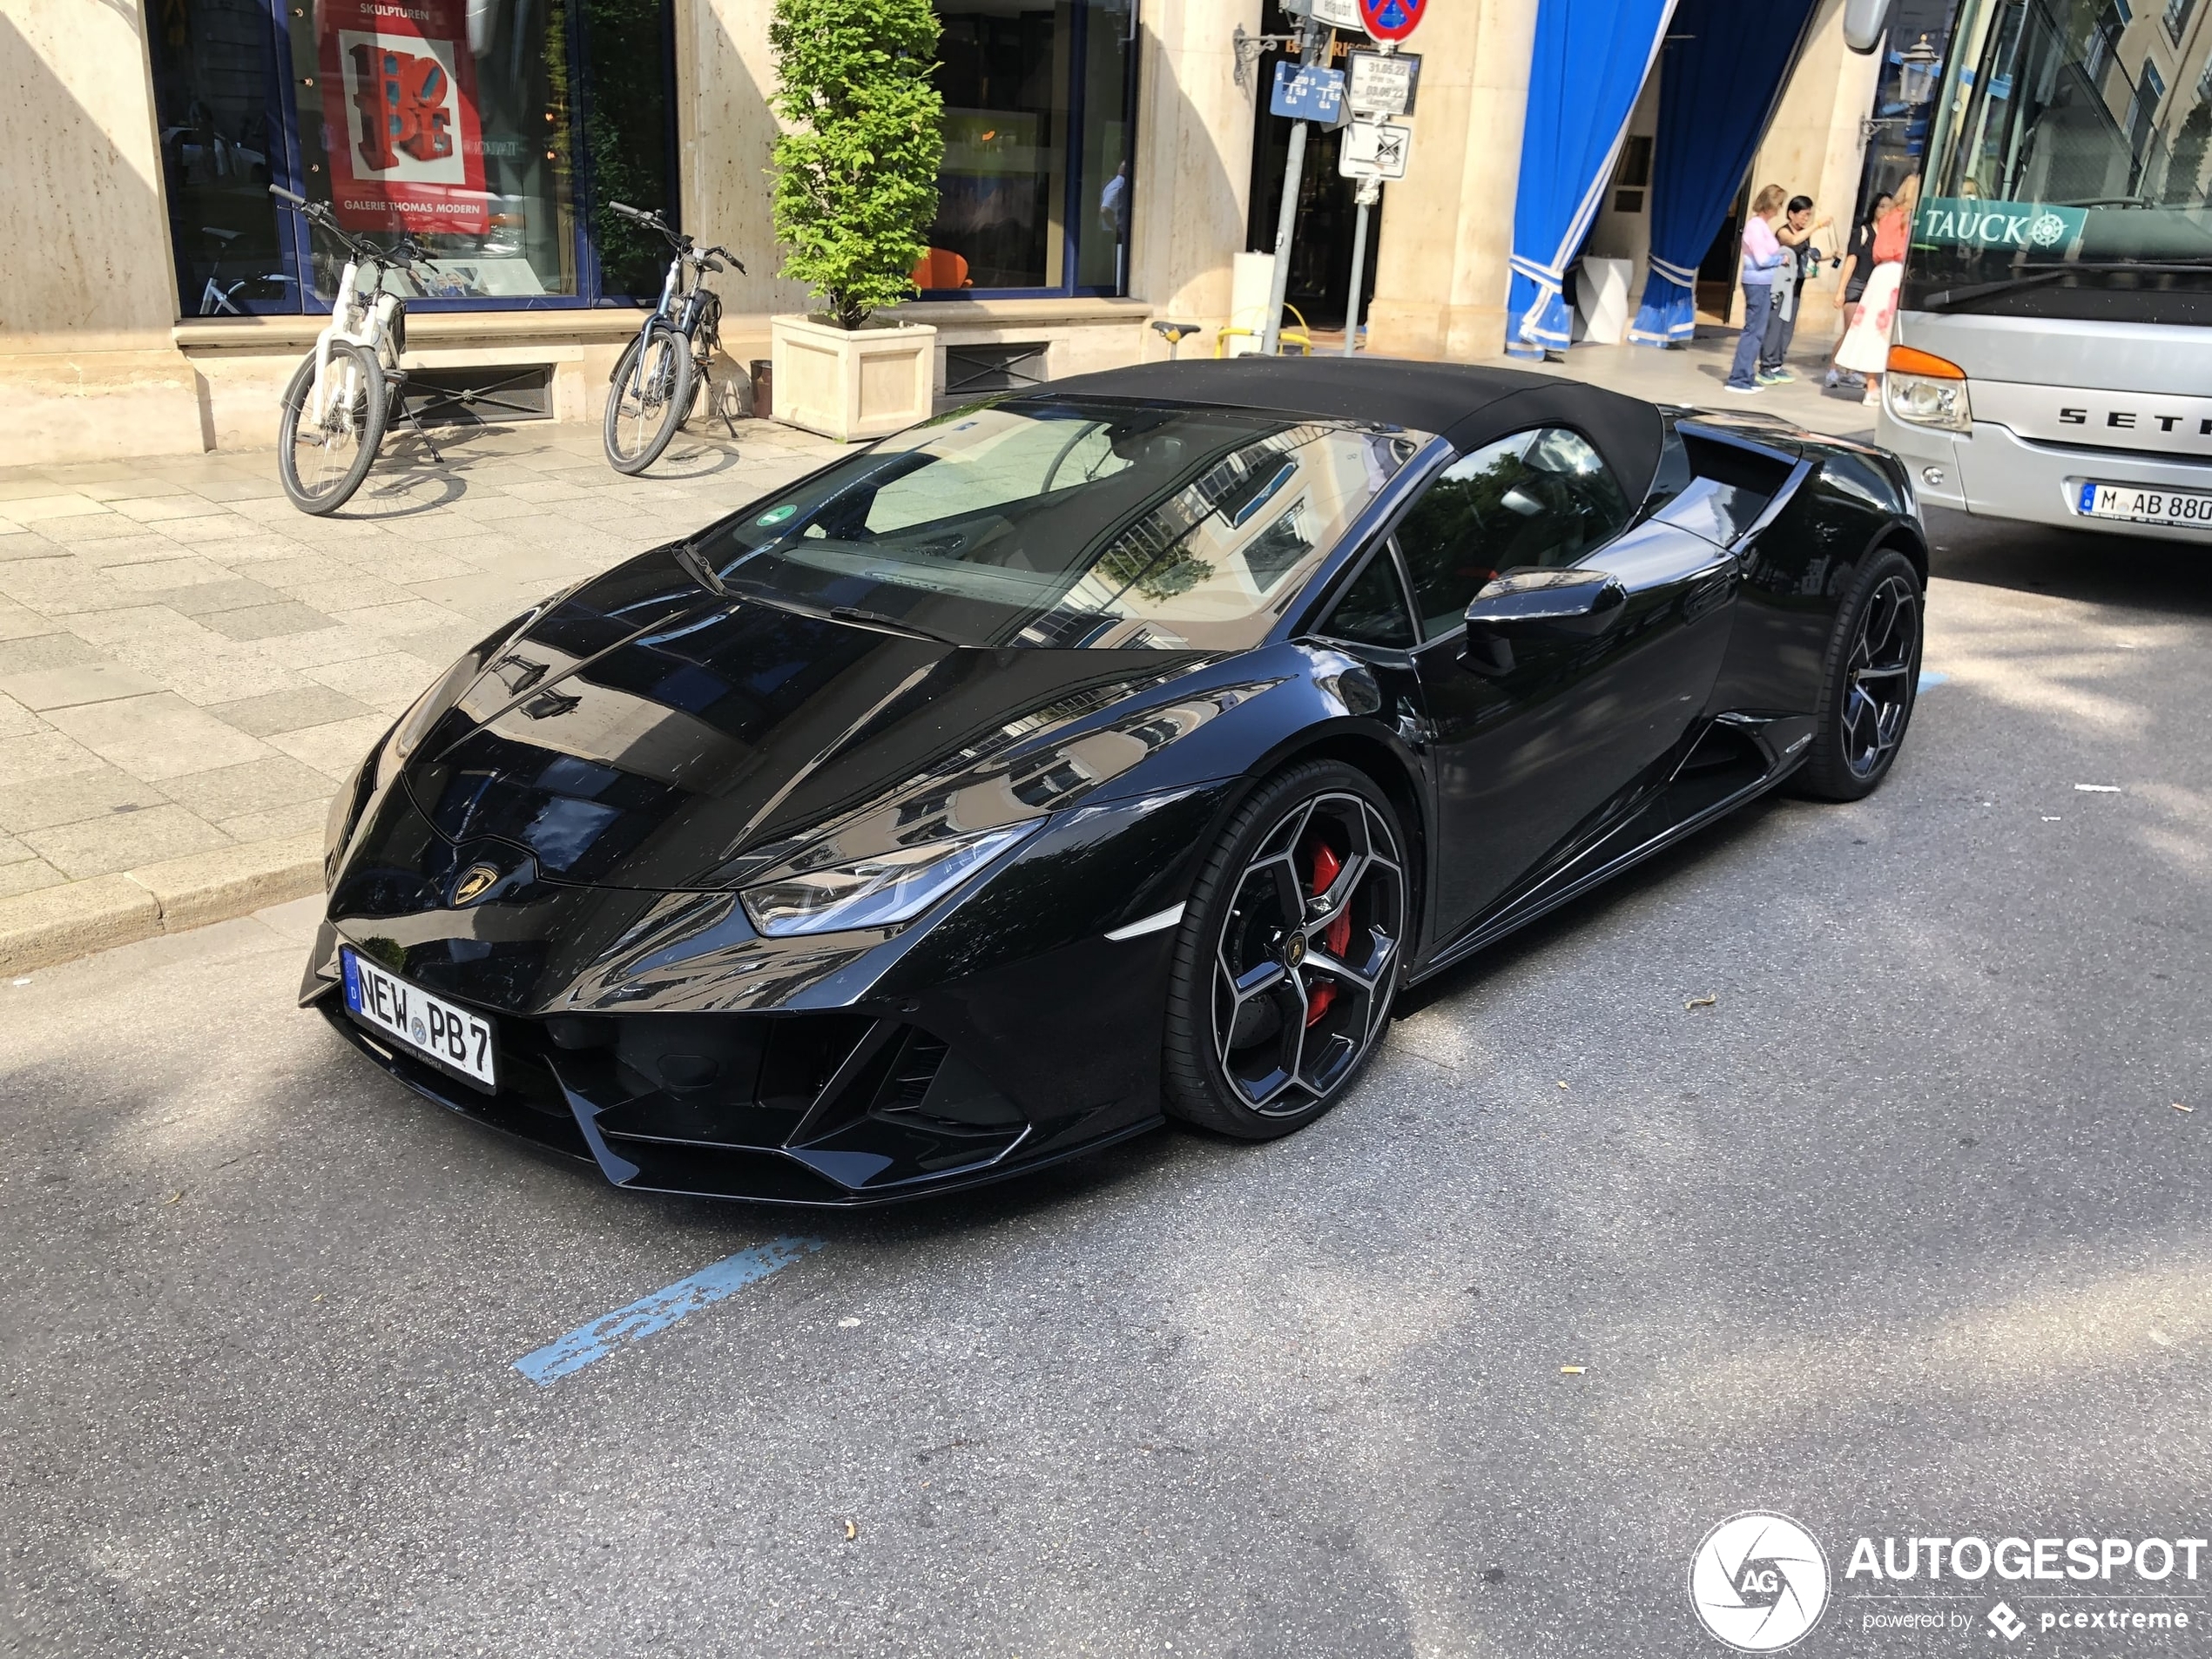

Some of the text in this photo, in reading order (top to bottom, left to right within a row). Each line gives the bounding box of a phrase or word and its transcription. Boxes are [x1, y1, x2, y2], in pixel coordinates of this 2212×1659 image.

[360, 3, 429, 21] SKULPTUREN
[344, 199, 480, 214] GALERIE THOMAS MODERN
[1925, 210, 2031, 245] TAUCK
[2101, 490, 2117, 509] M
[2132, 494, 2161, 515] AB
[358, 964, 408, 1033] NEW
